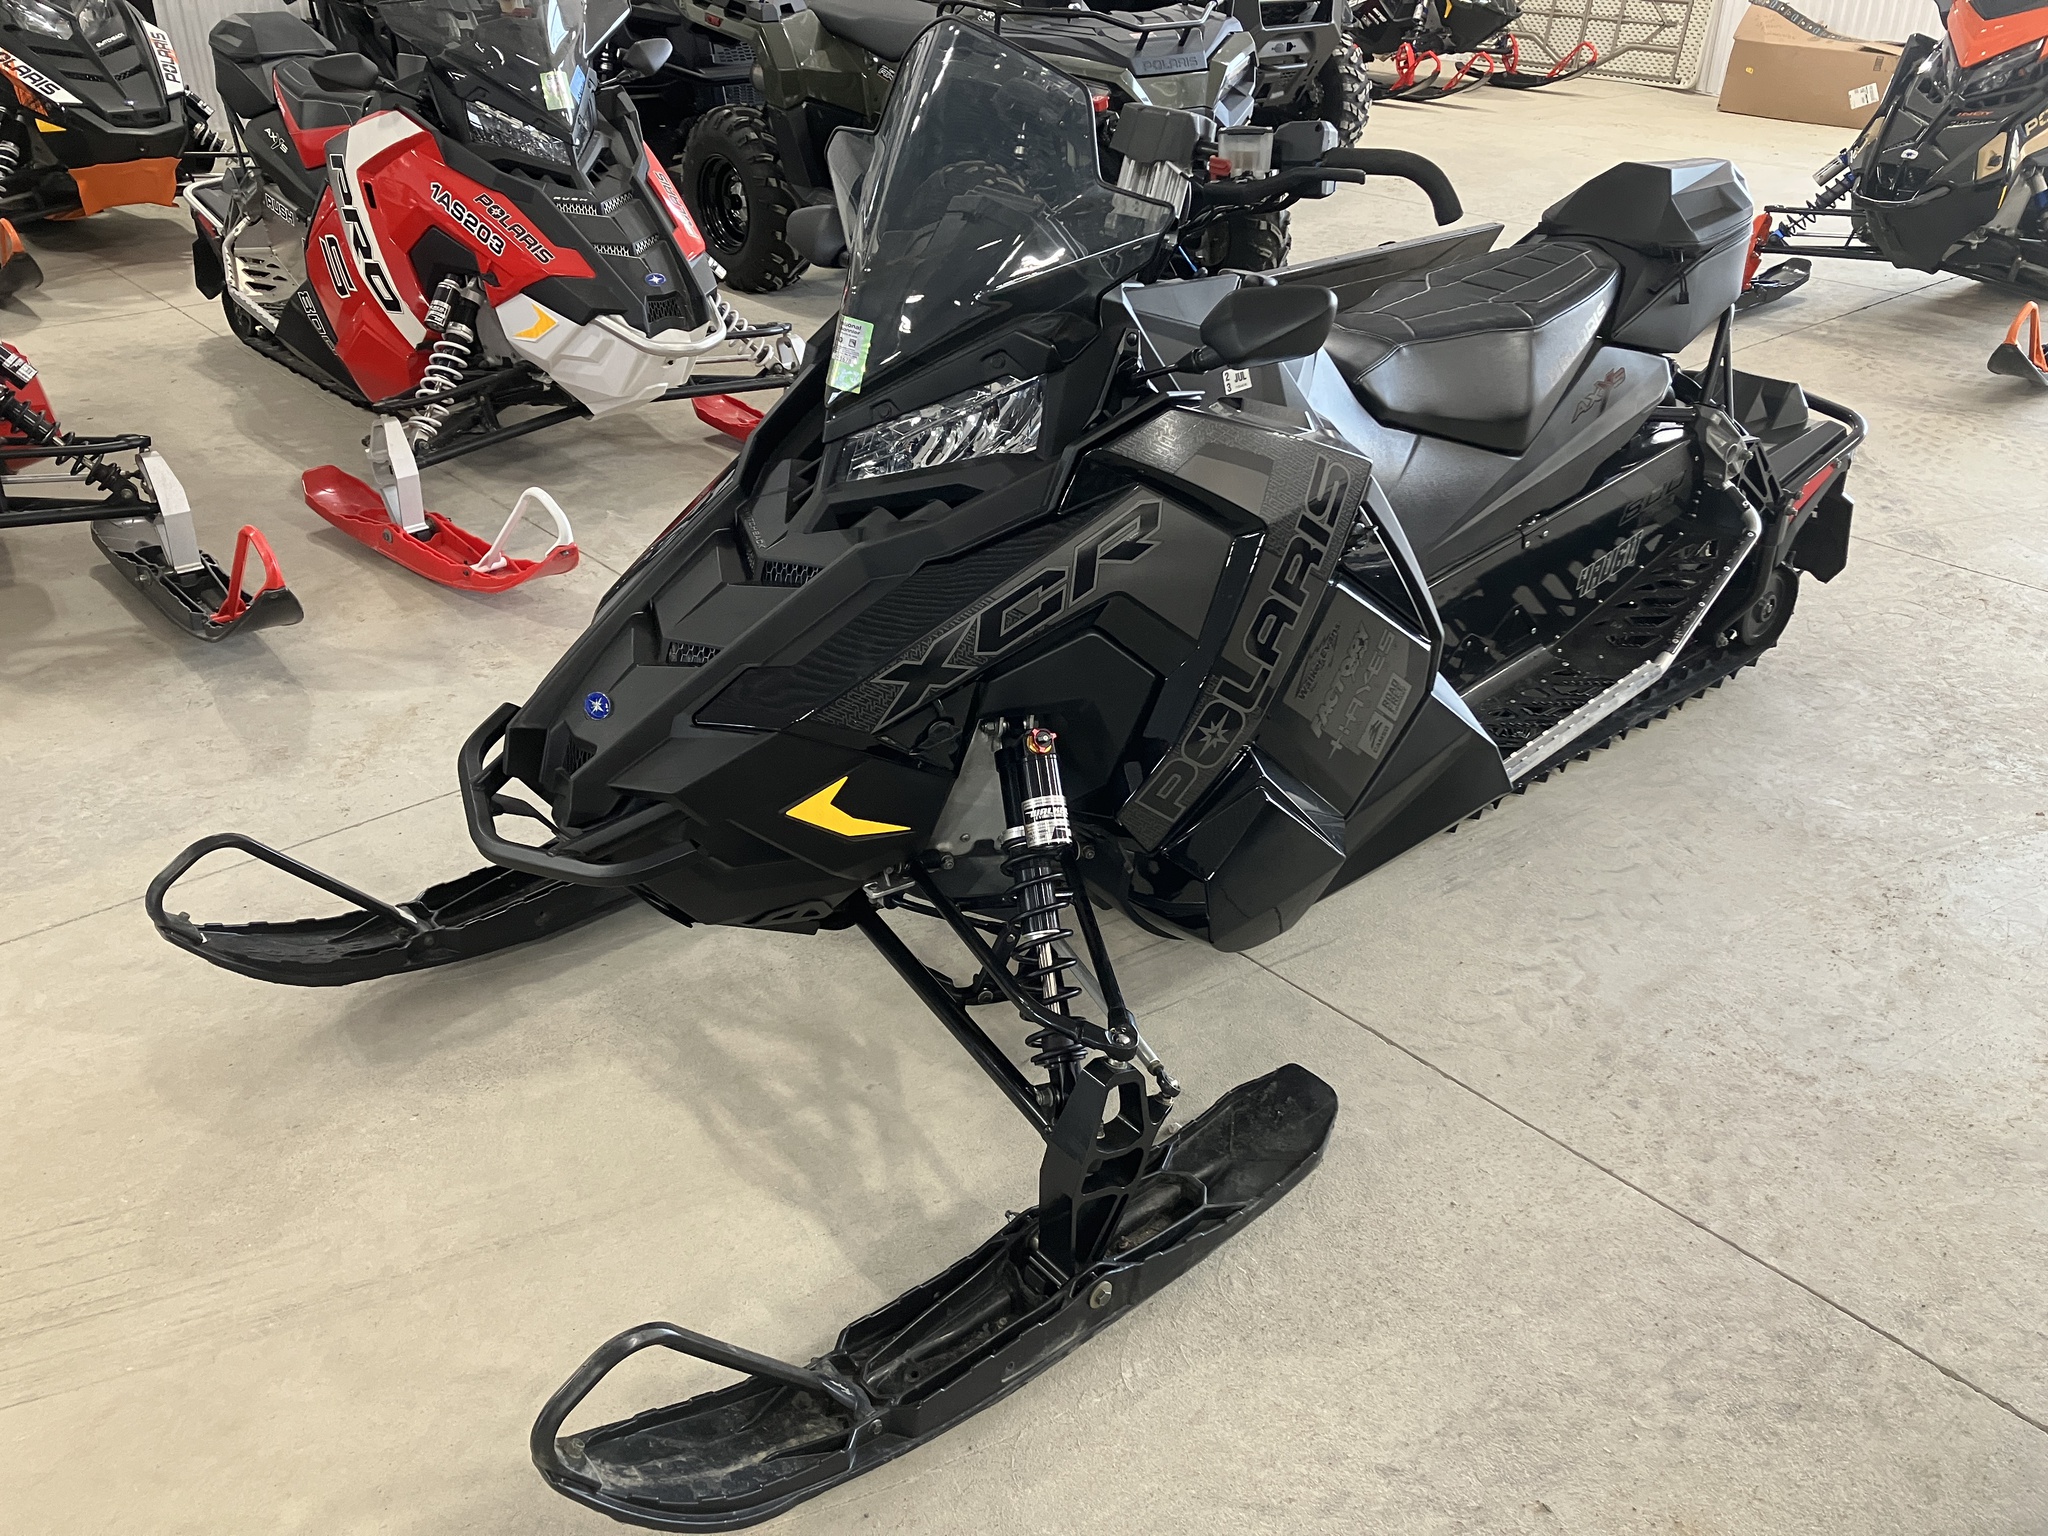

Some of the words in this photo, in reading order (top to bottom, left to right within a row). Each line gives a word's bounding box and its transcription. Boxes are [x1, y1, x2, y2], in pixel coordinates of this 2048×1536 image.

[151, 31, 181, 84] POLARIS
[1143, 56, 1199, 72] POLARIS
[264, 193, 295, 226] RUSH
[329, 153, 404, 314] PRO
[430, 182, 506, 256] 1AS203
[473, 193, 555, 264] POLARIS
[1234, 371, 1247, 383] JUL
[870, 498, 1163, 735] XCR
[1134, 453, 1351, 822] POLARIS
